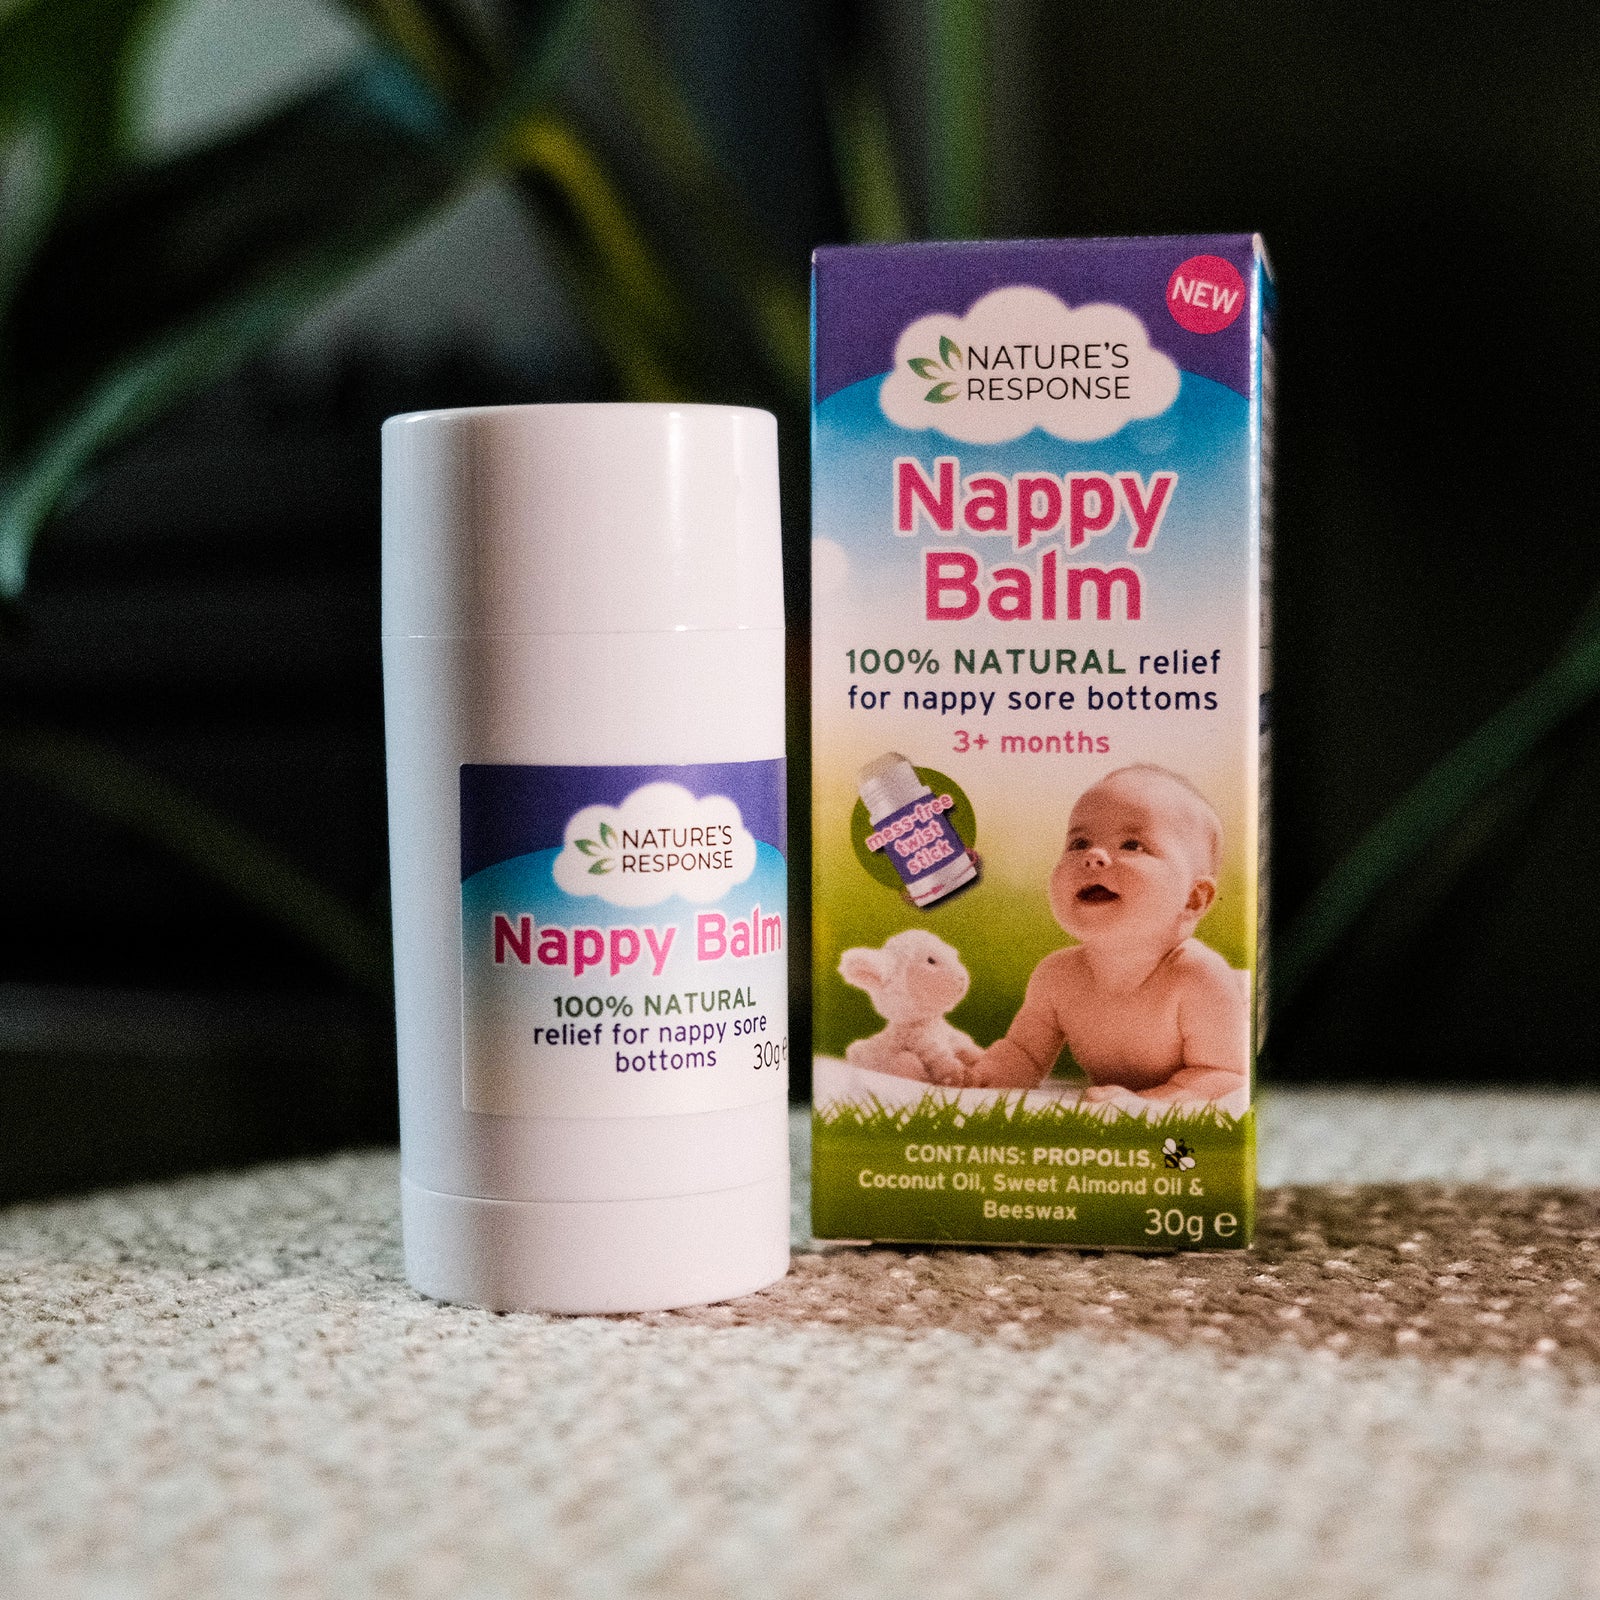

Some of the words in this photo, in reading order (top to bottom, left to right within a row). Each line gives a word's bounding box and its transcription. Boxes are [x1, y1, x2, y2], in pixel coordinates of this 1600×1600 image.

[1172, 276, 1239, 315] NEW
[967, 342, 1130, 370] NATURE'S
[967, 376, 1131, 401] RESPONSE
[897, 461, 1173, 548] Nappy
[925, 549, 1141, 620] Balm
[846, 649, 940, 674] 100%
[954, 649, 1126, 674] NATURAL
[1139, 650, 1221, 674] relief
[848, 685, 891, 709] for
[903, 690, 996, 716] nappy
[1008, 690, 1075, 710] sore
[1088, 685, 1218, 710] bottoms
[952, 731, 989, 753] 3+
[1000, 731, 1110, 754] months
[622, 825, 732, 849] NATURE'S
[866, 794, 953, 852] mess-free
[895, 821, 943, 857] twist
[622, 850, 733, 873] RESPONSE
[907, 839, 954, 875] stick
[494, 915, 677, 977] Nappy
[697, 907, 782, 961] Balm
[553, 996, 633, 1017] 100%
[645, 987, 756, 1016] NATURAL
[534, 1023, 602, 1045] relief
[613, 1023, 650, 1045] for
[659, 1021, 727, 1045] nappy
[733, 1015, 767, 1036] sore
[616, 1050, 717, 1073] bottoms
[753, 1041, 780, 1070] 30g
[905, 1145, 1025, 1164] CONTAINS:
[859, 1171, 945, 1190] Coconut
[952, 1172, 986, 1193] Oil,
[993, 1173, 1058, 1194] Sweet
[1065, 1175, 1146, 1195] Almond
[1154, 1175, 1181, 1195] Oil
[1189, 1177, 1204, 1196] &
[984, 1202, 1077, 1220] Beeswax
[1144, 1209, 1203, 1241] 30g
